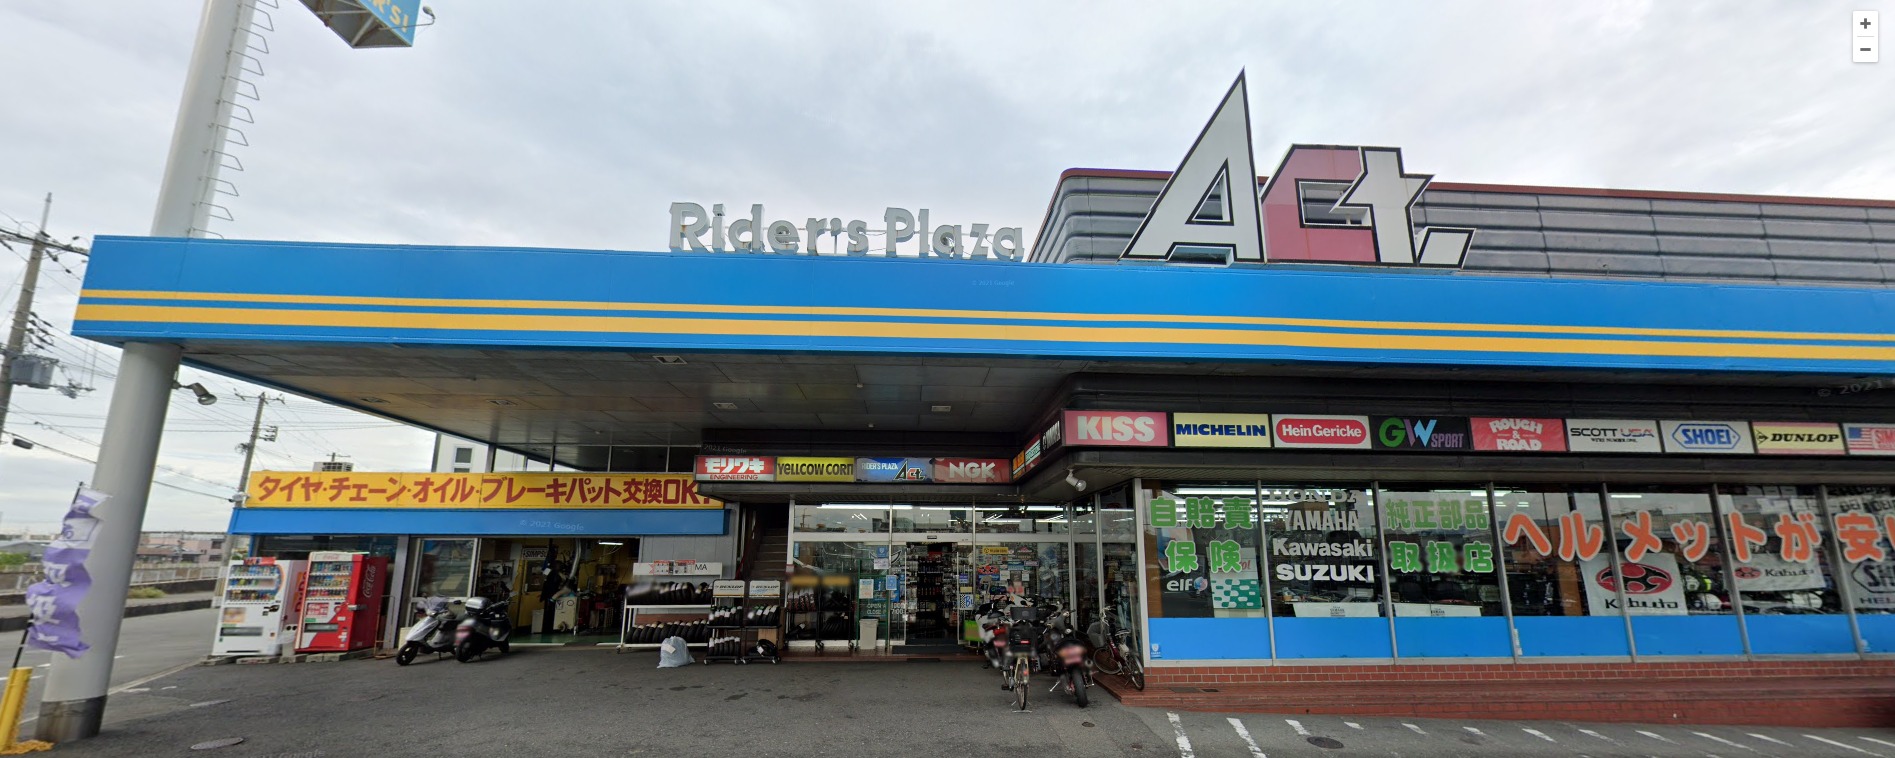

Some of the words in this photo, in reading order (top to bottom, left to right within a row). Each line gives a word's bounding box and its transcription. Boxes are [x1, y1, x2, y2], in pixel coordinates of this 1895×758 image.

[669, 201, 869, 257] Rider's
[884, 206, 1025, 262] Plaza
[1077, 415, 1155, 442] KISS
[1176, 423, 1266, 437] MICHELIN
[1282, 424, 1312, 437] Hein
[1312, 424, 1362, 438] Gericke
[1378, 417, 1437, 448] GW
[1431, 433, 1464, 448] SPORT
[1489, 418, 1543, 434] ROUGH
[1571, 428, 1618, 437] SCOTT
[1620, 428, 1654, 438] USA
[1512, 431, 1520, 439] &
[1683, 428, 1732, 445] SHOEI
[1770, 433, 1839, 442] DUNLOP
[1496, 439, 1542, 450] ROAD
[705, 457, 765, 473] モリワキ
[862, 462, 881, 470] RIDER'S
[882, 462, 898, 470] PLAZA
[949, 462, 996, 479] NGK
[1269, 489, 1360, 503] HONDA
[1150, 496, 1253, 529] 自賠責
[1282, 510, 1360, 531] YAMAHA
[1385, 498, 1489, 530] 純正部品
[1272, 538, 1373, 557] Kawasaki
[1165, 540, 1242, 573] 保険
[1389, 540, 1494, 573] 取扱店
[1276, 563, 1374, 583] SUZUKI
[1166, 578, 1193, 592] elf
[1605, 597, 1678, 609] Kbuto
